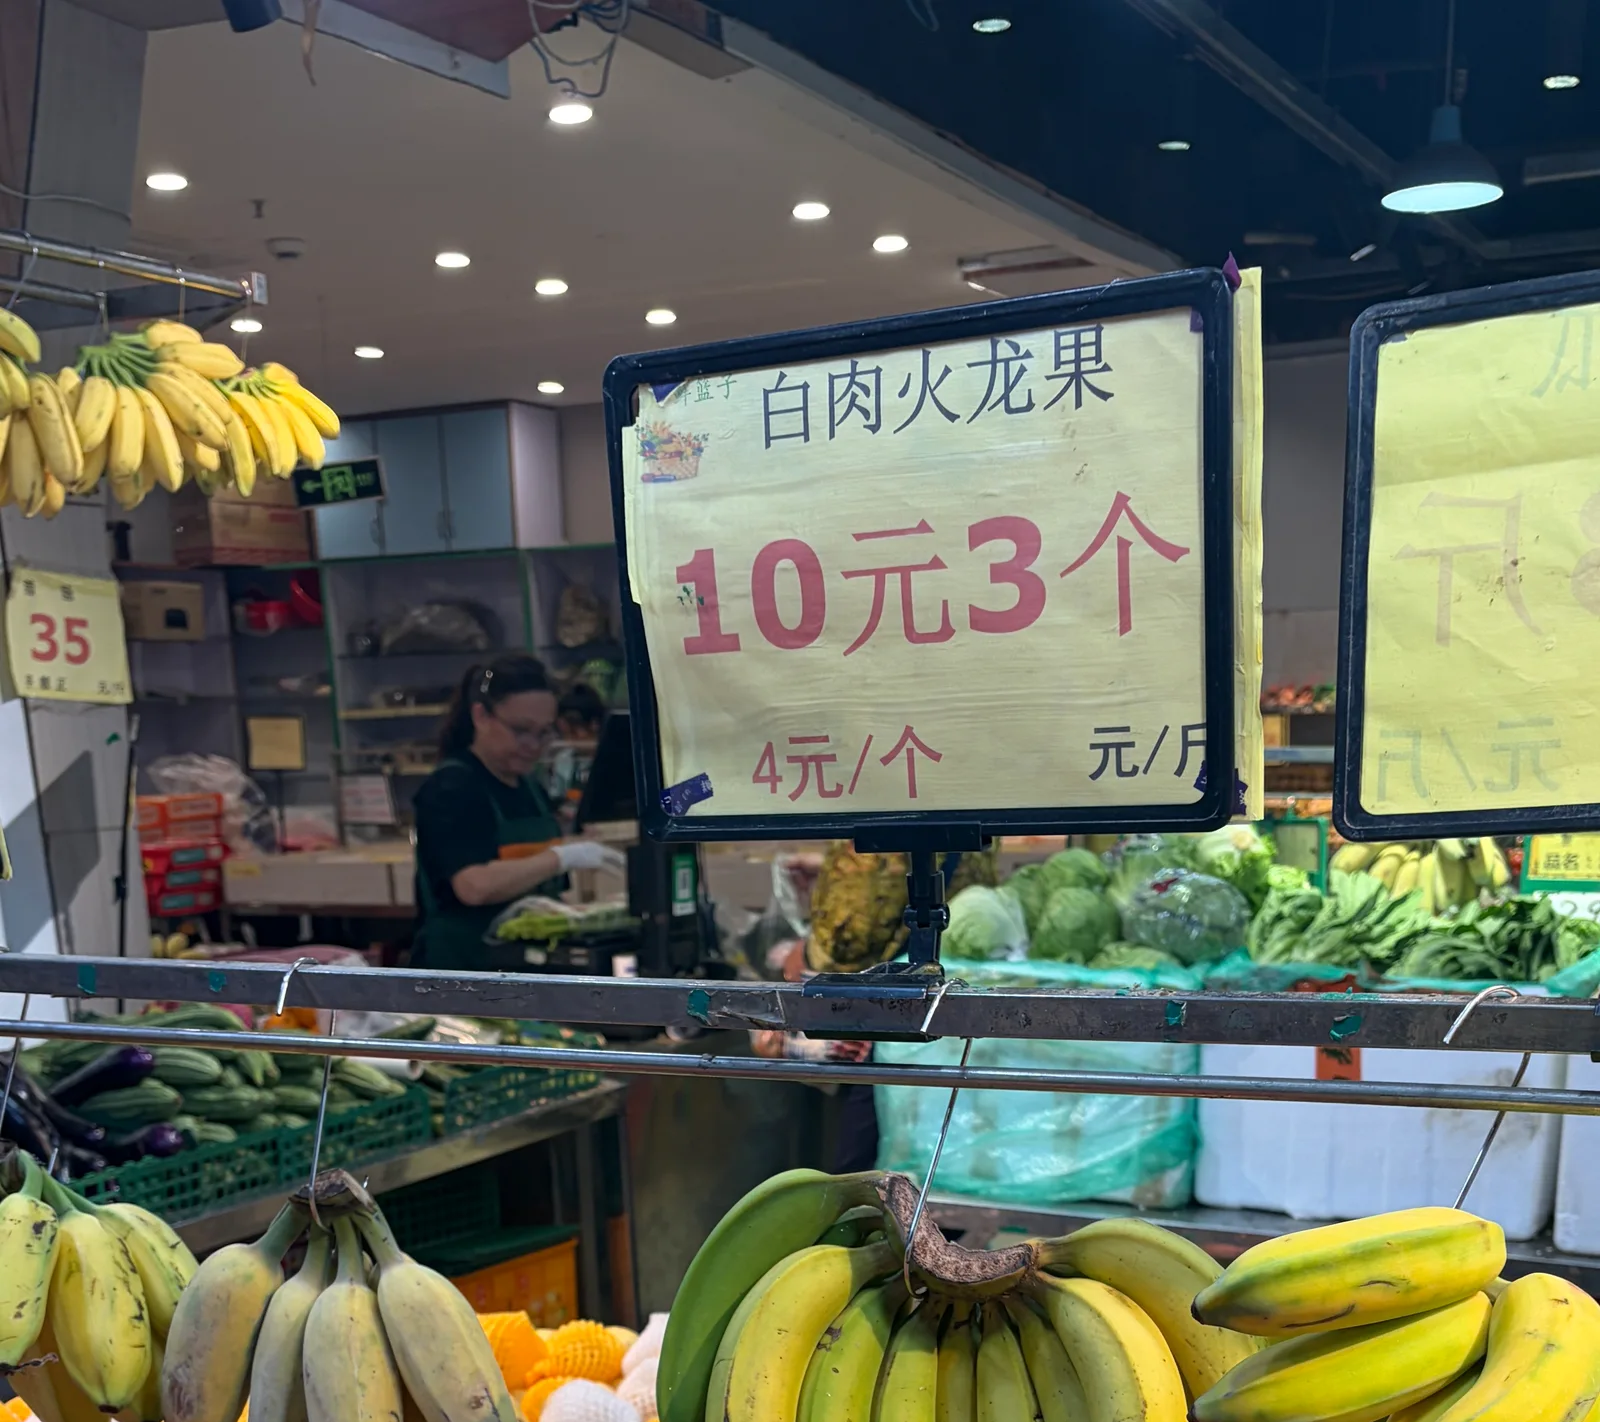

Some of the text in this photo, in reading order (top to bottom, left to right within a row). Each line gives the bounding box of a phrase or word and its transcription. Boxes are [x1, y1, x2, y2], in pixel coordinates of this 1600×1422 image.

[763, 324, 1115, 449] 白肉火龙果
[674, 490, 1191, 657] 10元3个
[29, 612, 92, 666] 35
[751, 725, 944, 801] 4元/个
